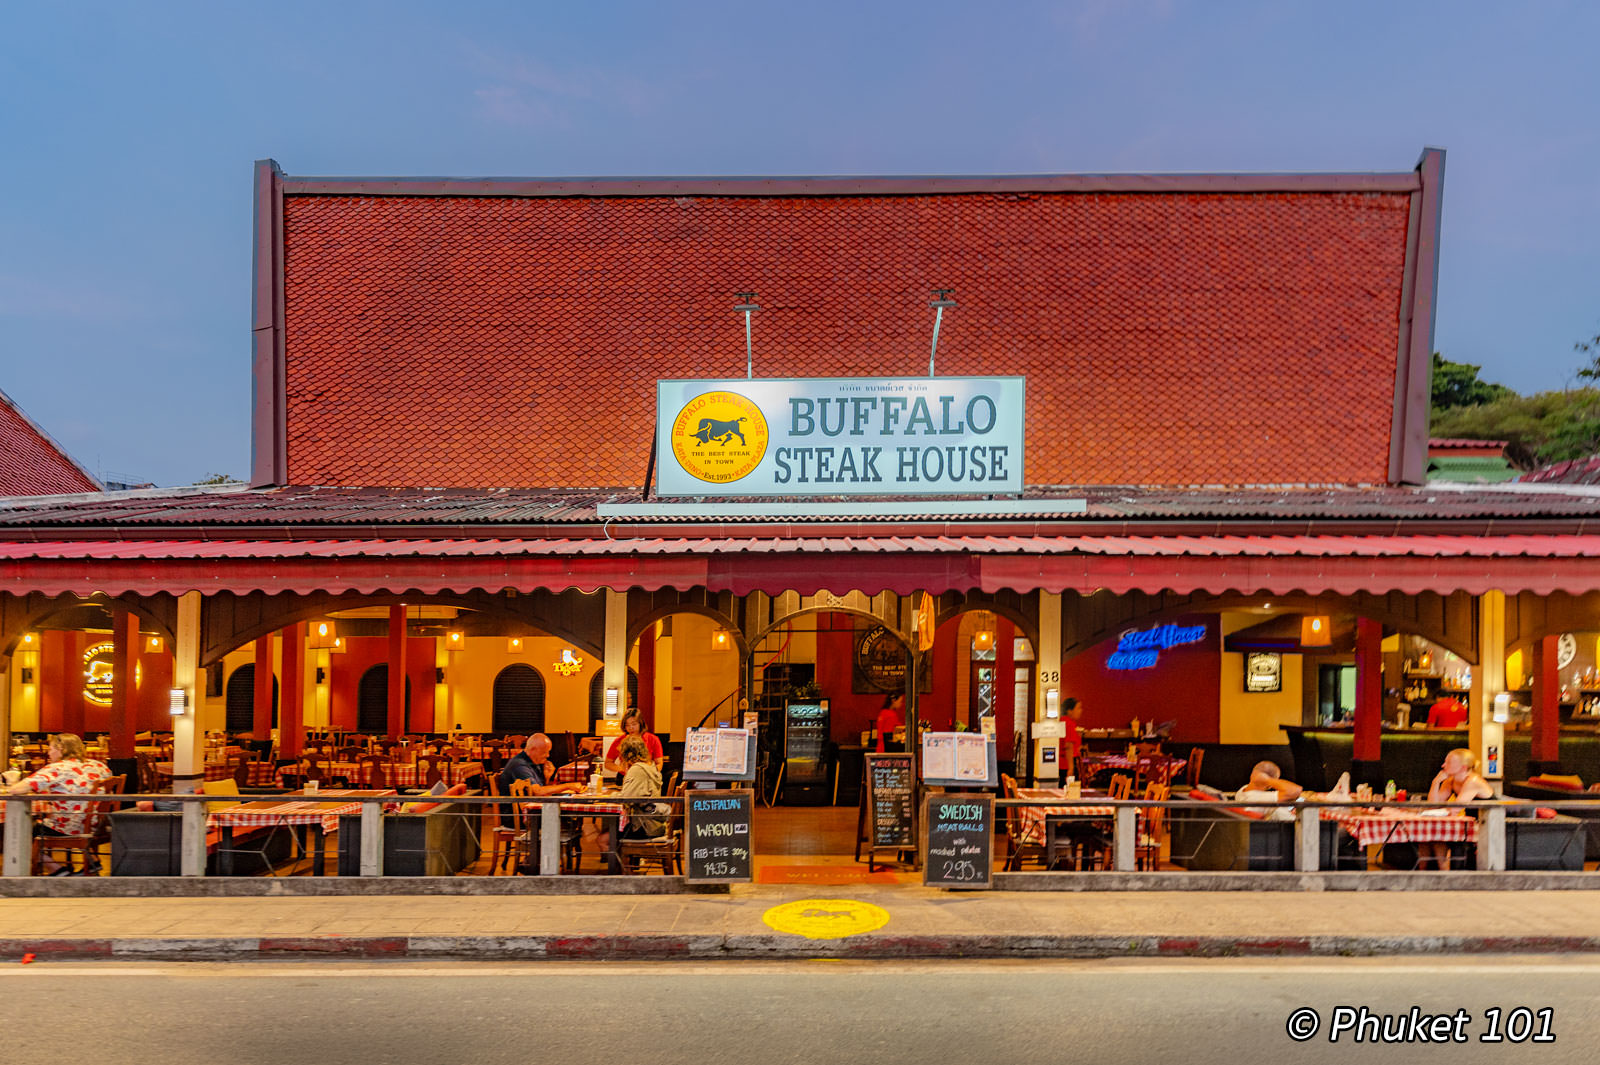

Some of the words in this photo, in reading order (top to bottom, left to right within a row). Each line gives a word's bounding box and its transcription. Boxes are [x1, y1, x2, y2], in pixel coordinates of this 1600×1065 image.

[676, 399, 706, 436] BUFFALO
[710, 394, 744, 408] STEAK
[744, 405, 765, 436] HOUSE
[788, 395, 997, 436] BUFFALO
[774, 447, 882, 483] STEAK
[896, 445, 1008, 482] HOUSE
[1041, 671, 1059, 682] 38
[693, 799, 741, 811] AUSTRALIAN
[938, 804, 983, 820] SWEDISH
[696, 823, 734, 837] WAGYU
[943, 860, 976, 881] 295
